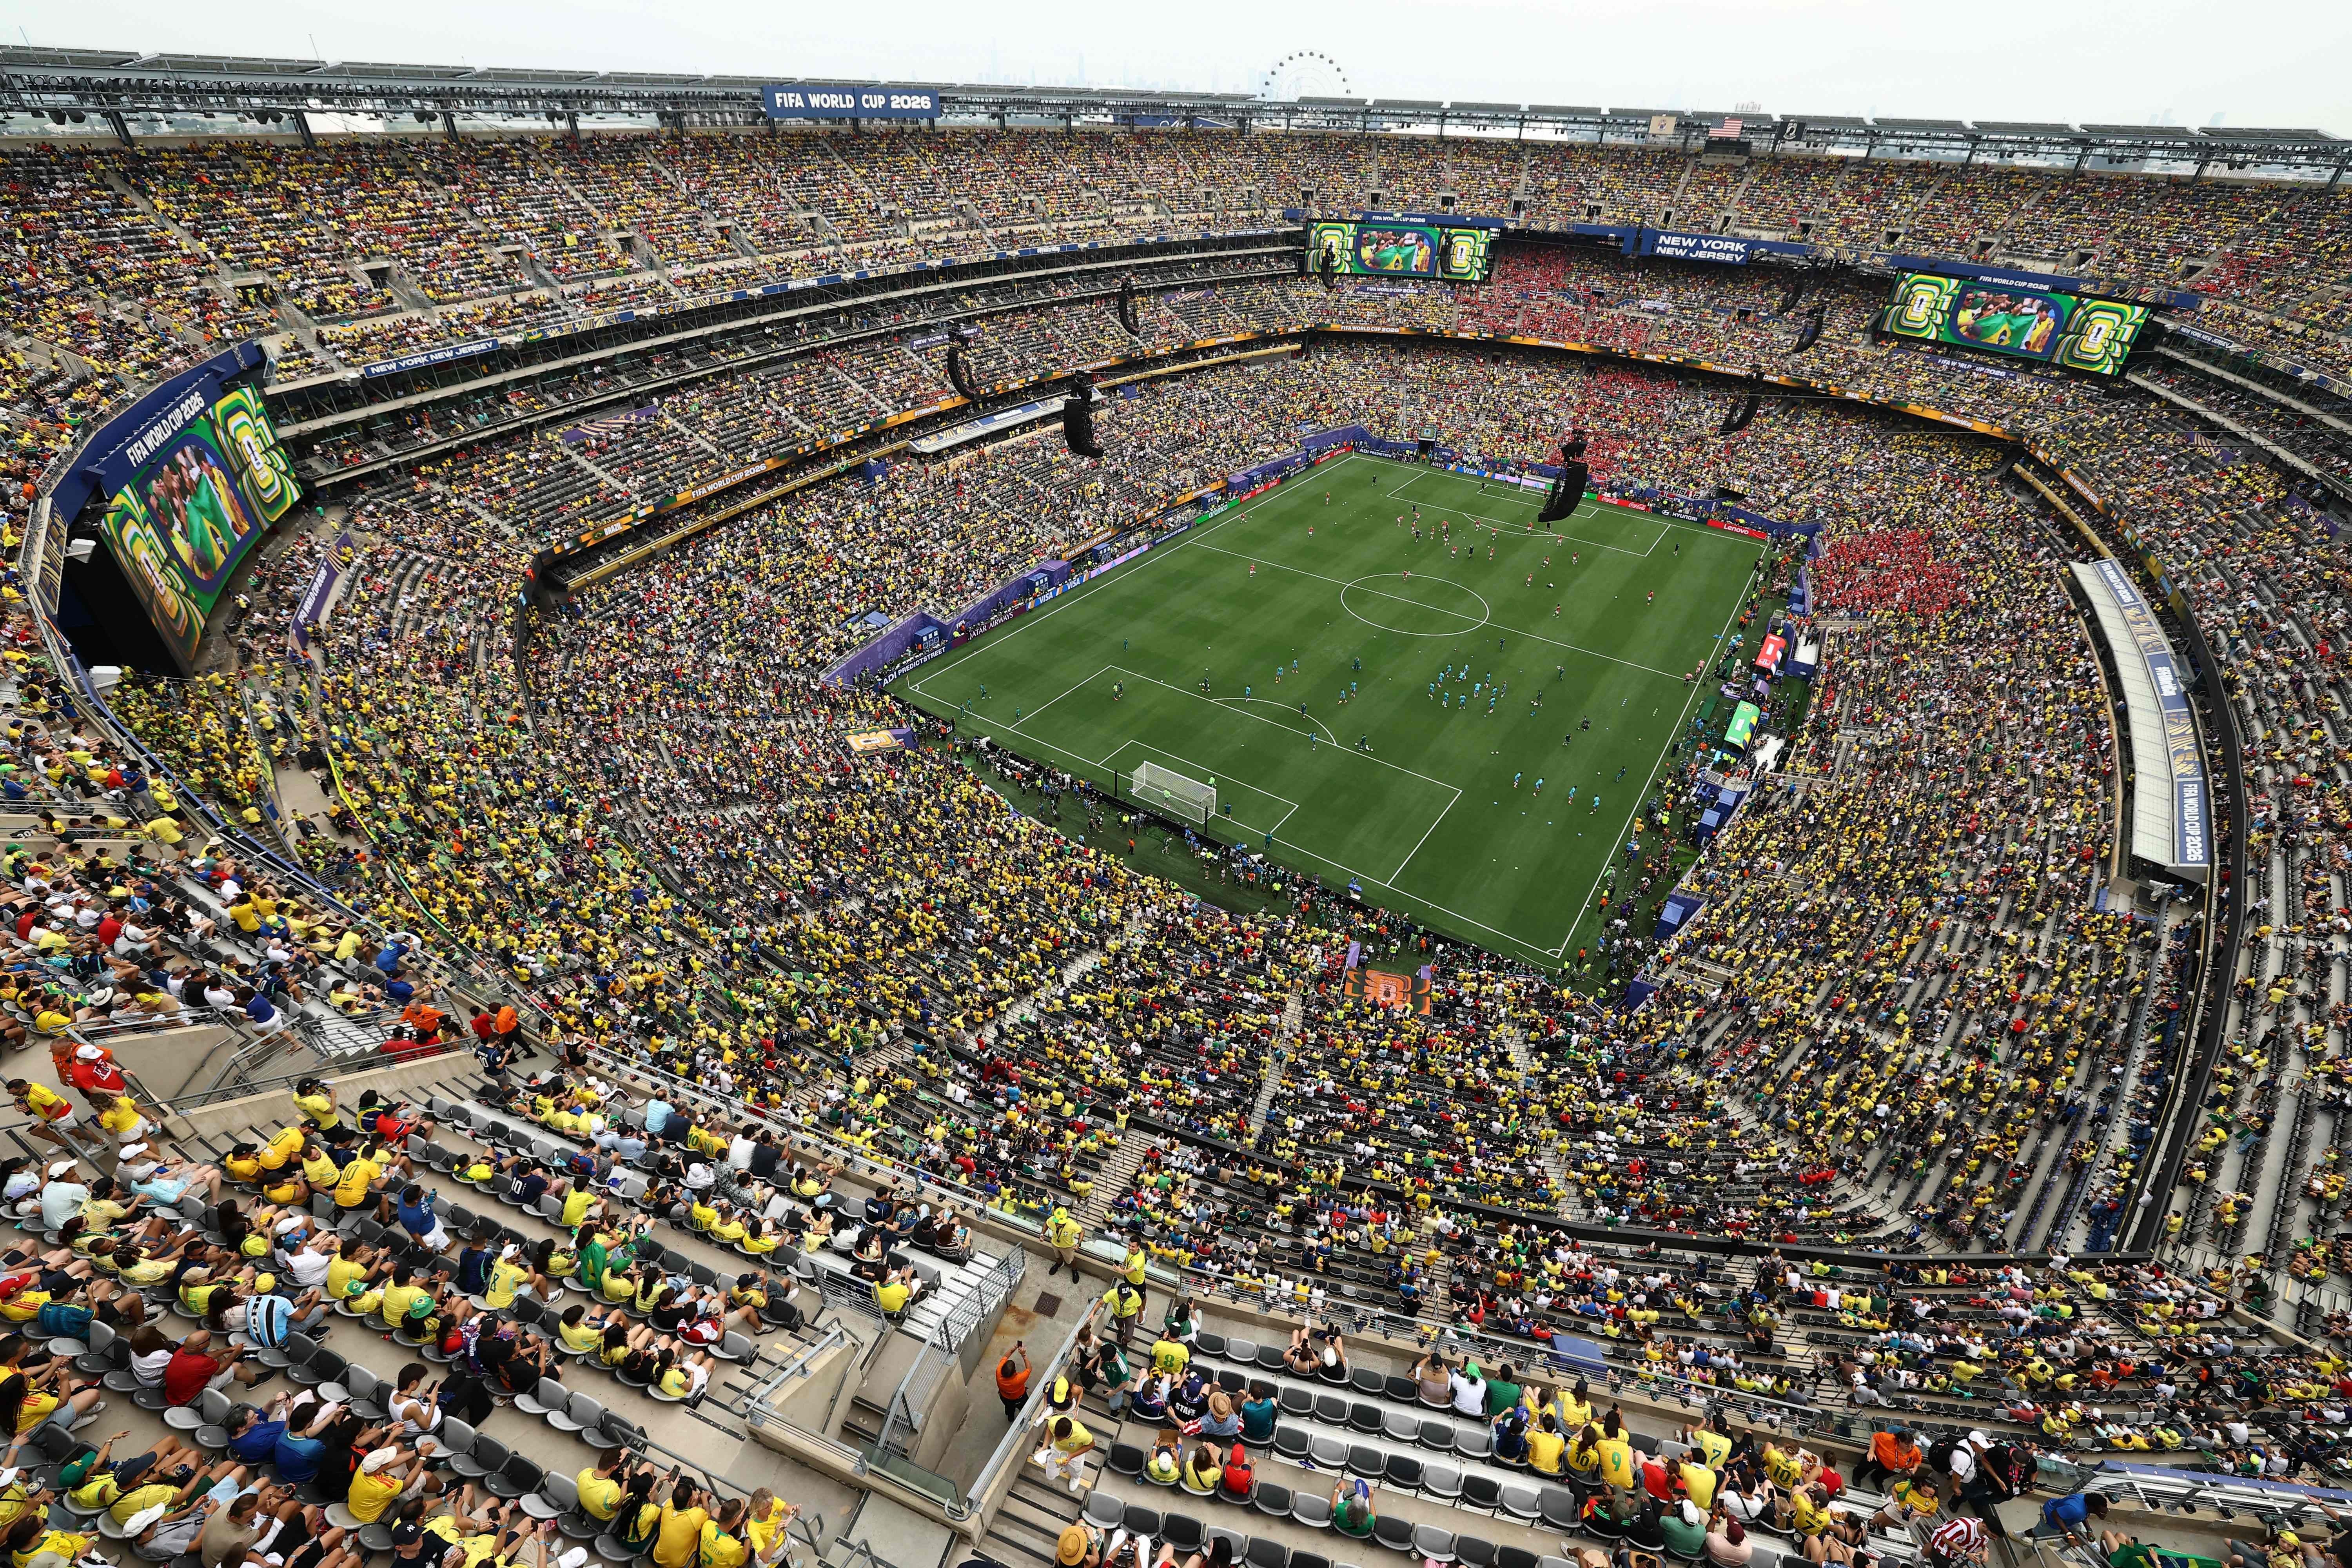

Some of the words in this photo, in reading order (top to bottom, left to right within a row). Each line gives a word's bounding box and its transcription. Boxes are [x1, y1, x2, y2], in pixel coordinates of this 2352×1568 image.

[775, 93, 804, 108] FIFA
[808, 93, 855, 109] WORLD
[862, 94, 886, 109] CUP
[890, 95, 931, 109] 2026
[1658, 236, 1697, 247] NEW
[1700, 240, 1748, 252] YORK
[1656, 247, 1688, 256] NEW
[1689, 251, 1745, 262] JERSEY
[2028, 282, 2050, 291] 2026
[2180, 327, 2191, 335] NEW
[2190, 330, 2202, 339] YORK
[2211, 338, 2230, 347] JERSEY
[370, 361, 397, 376] NEW
[399, 354, 430, 369] YORK
[430, 348, 454, 363] NEW
[455, 341, 493, 359] JERSEY
[1087, 361, 1095, 369] CUP
[1096, 359, 1111, 367] 2026
[1725, 367, 1746, 375] WORLD
[1985, 368, 2006, 376] 2026
[914, 405, 940, 416] #FIFAWorldCup
[126, 440, 150, 467] FIFA
[142, 419, 173, 453] WORLD
[168, 408, 190, 431] CUP
[181, 391, 205, 424] 2026
[1294, 466, 1306, 474] HYUNDAI
[1463, 466, 1477, 475] VISA
[691, 487, 707, 499] FIFA
[706, 477, 731, 492] WORLD
[731, 472, 744, 483] CUP
[744, 463, 767, 477] 2026
[1269, 479, 1278, 488] Coca-Cola
[1255, 485, 1265, 494] Coca-Cola
[1662, 484, 1690, 497] CAMISA
[2067, 474, 2076, 483] FIFA
[2073, 479, 2085, 493] WORLD
[2088, 491, 2099, 504] 2026
[1241, 492, 1252, 501] Coca-Cola
[1601, 495, 1619, 505] Coca-Cola
[1209, 505, 1228, 518] aramco
[1628, 501, 1646, 510] Coca-Cola
[1672, 512, 1698, 522] HYUNDAI
[604, 522, 622, 535] BRAZIL
[1178, 525, 1189, 533] 2026
[1723, 523, 1749, 535] Lenovo
[1066, 550, 1075, 558] FIFA
[1075, 542, 1089, 553] WORLD
[1090, 537, 1098, 546] CUP
[1098, 531, 1112, 542] 2026
[2100, 562, 2112, 571] FIFA
[315, 563, 328, 587] 2026
[2105, 568, 2120, 583] WORLD
[310, 580, 321, 597] CUP
[1066, 578, 1080, 590] VISA
[2113, 581, 2126, 590] CUP
[302, 591, 316, 613] WORLD
[1038, 592, 1053, 604] VISA
[2118, 587, 2135, 604] 2026
[298, 610, 308, 626] FIFA
[956, 619, 965, 629] FIFA
[989, 611, 1013, 629] AIRWAYS
[881, 671, 897, 687] ADI
[898, 646, 946, 675] PREDICTSTREET
[2183, 784, 2197, 797] FIFA
[2183, 797, 2199, 820] WORLD
[2185, 821, 2200, 836] CUP
[2186, 836, 2204, 862] 2026
[478, 1056, 488, 1068] 10
[270, 1132, 288, 1146] 10
[688, 1134, 699, 1145] 10
[703, 1142, 713, 1154] 10
[979, 1145, 985, 1154] 10
[342, 1165, 356, 1181] 10
[511, 1179, 524, 1195] 10
[1179, 1256, 1187, 1265] 10
[1163, 1354, 1174, 1367] 8
[1175, 1403, 1196, 1416] STAFF
[1575, 1454, 1590, 1466] 10
[1612, 1452, 1621, 1472] 9
[1710, 1449, 1722, 1464] 7
[1772, 1465, 1791, 1482] 10
[1802, 1519, 1818, 1532] 7
[701, 1550, 713, 1568] 2
